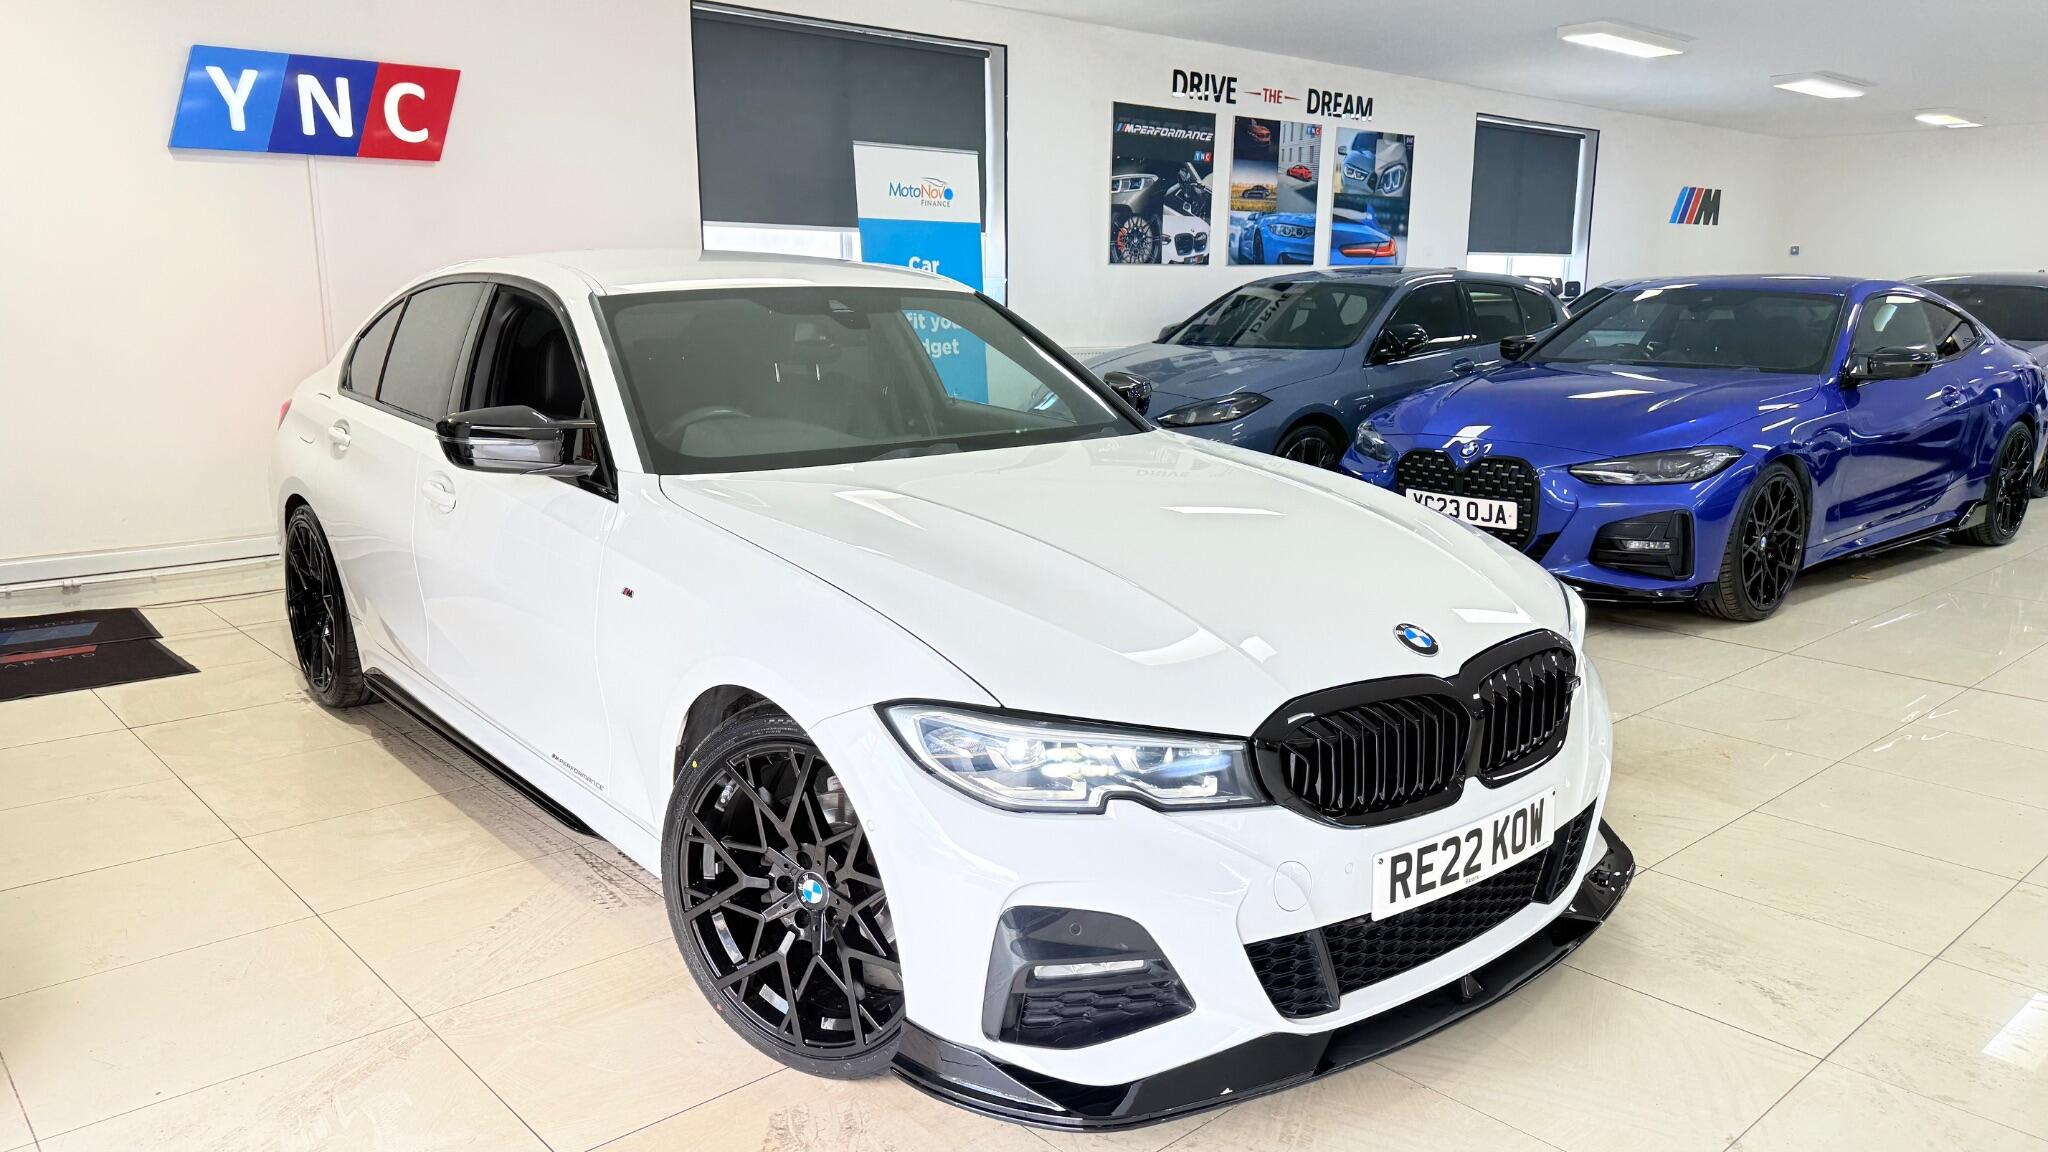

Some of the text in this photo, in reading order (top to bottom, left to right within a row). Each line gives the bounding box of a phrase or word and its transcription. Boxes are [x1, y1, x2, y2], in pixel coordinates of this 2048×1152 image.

[205, 65, 429, 143] YNC
[1172, 69, 1374, 122] DRIVE THE DREAM
[920, 200, 951, 208] FINANCE
[908, 256, 940, 274] Car
[1466, 501, 1507, 525] OJA
[1390, 797, 1545, 904] RE22 KOW
